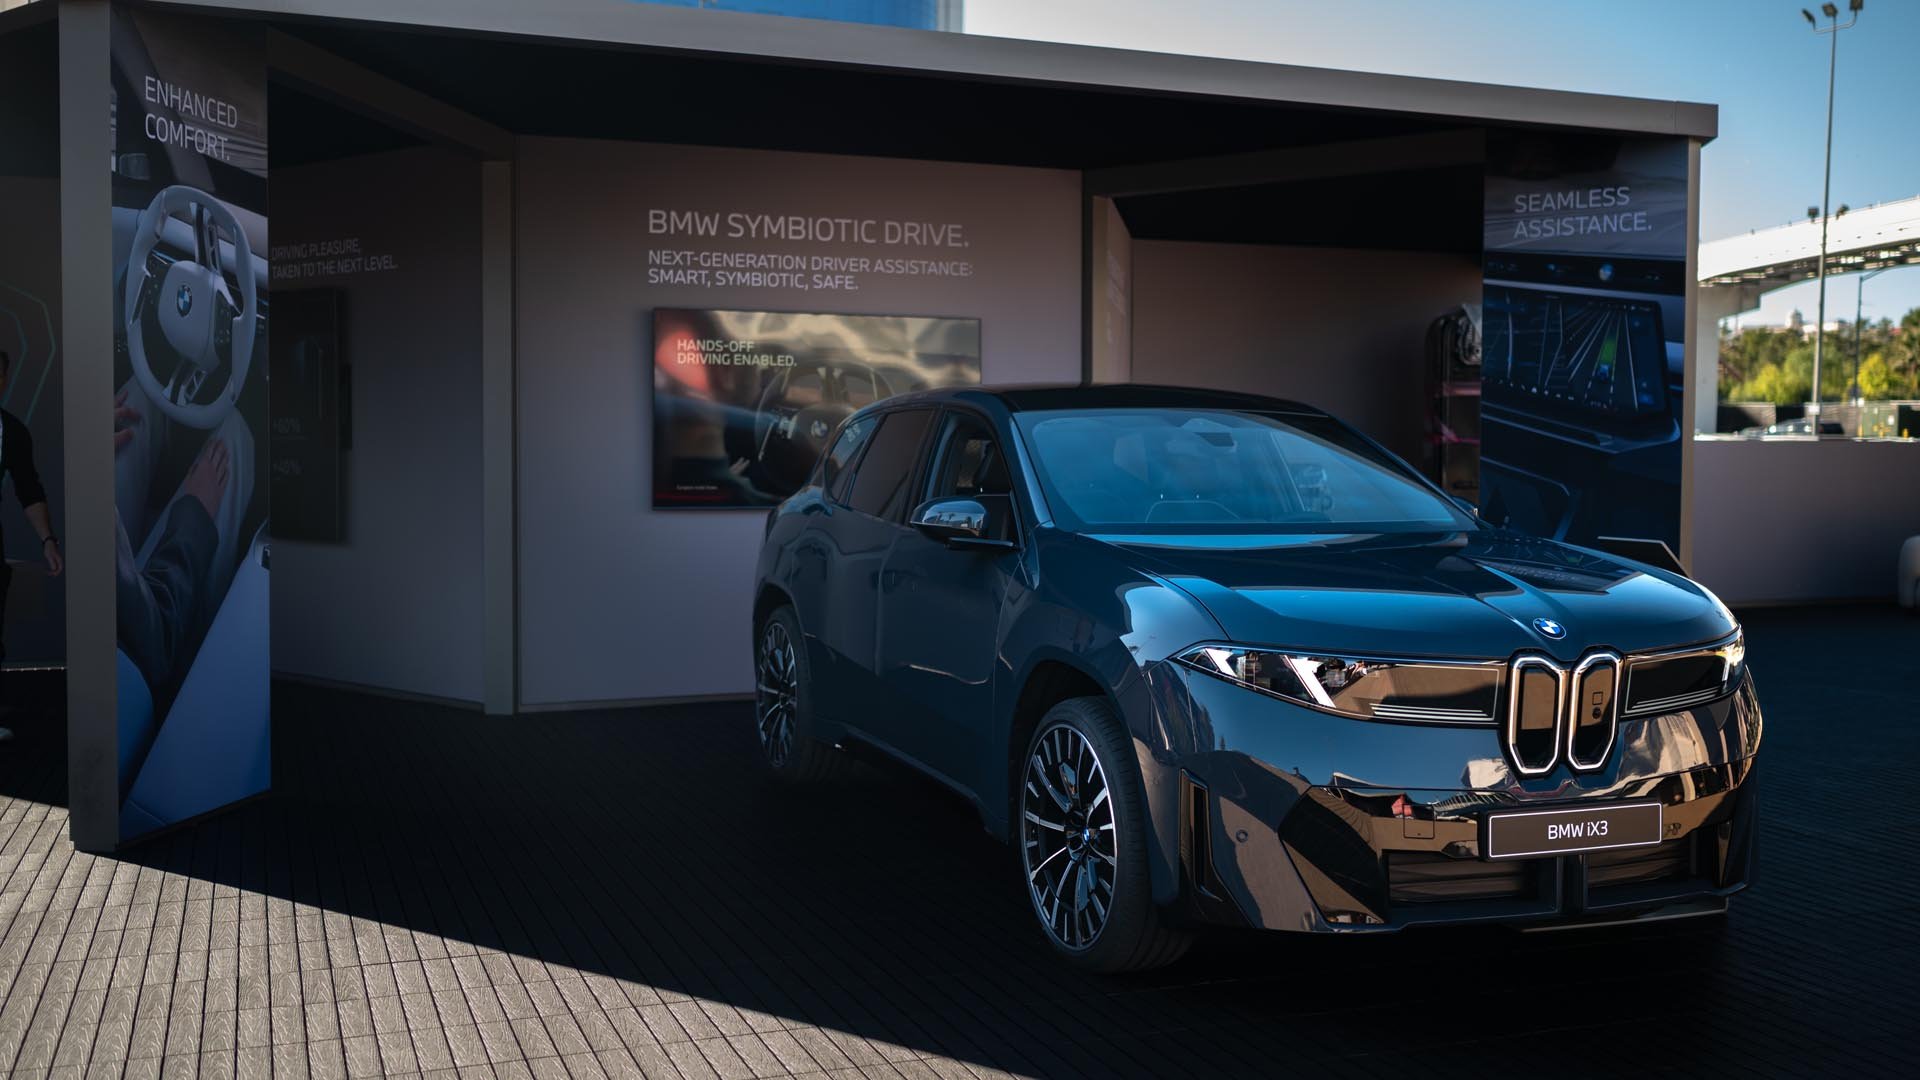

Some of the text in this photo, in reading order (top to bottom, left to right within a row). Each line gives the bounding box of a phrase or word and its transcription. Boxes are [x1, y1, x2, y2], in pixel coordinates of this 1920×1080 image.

[145, 75, 238, 128] ENHANCED
[145, 113, 230, 161] COMFORT.
[1514, 186, 1630, 213] SEAMLESS
[648, 209, 969, 247] BMW SYMBIOTIC DRIVE.
[1513, 211, 1653, 238] ASSISTANCE.
[271, 243, 308, 260] DRIVING
[648, 250, 973, 276] NEXT-GENERATION DRIVER ASSISTANCE:
[272, 262, 301, 279] TAKEN
[302, 261, 315, 277] TO
[316, 259, 336, 276] THE
[337, 257, 363, 274] NEXT
[648, 268, 859, 291] SMART, SYMBIOTIC, SAFE.
[677, 339, 755, 353] HANDS-OFF
[677, 352, 798, 367] DRIVING ENABLED.
[1548, 820, 1608, 840] BMW iX3
